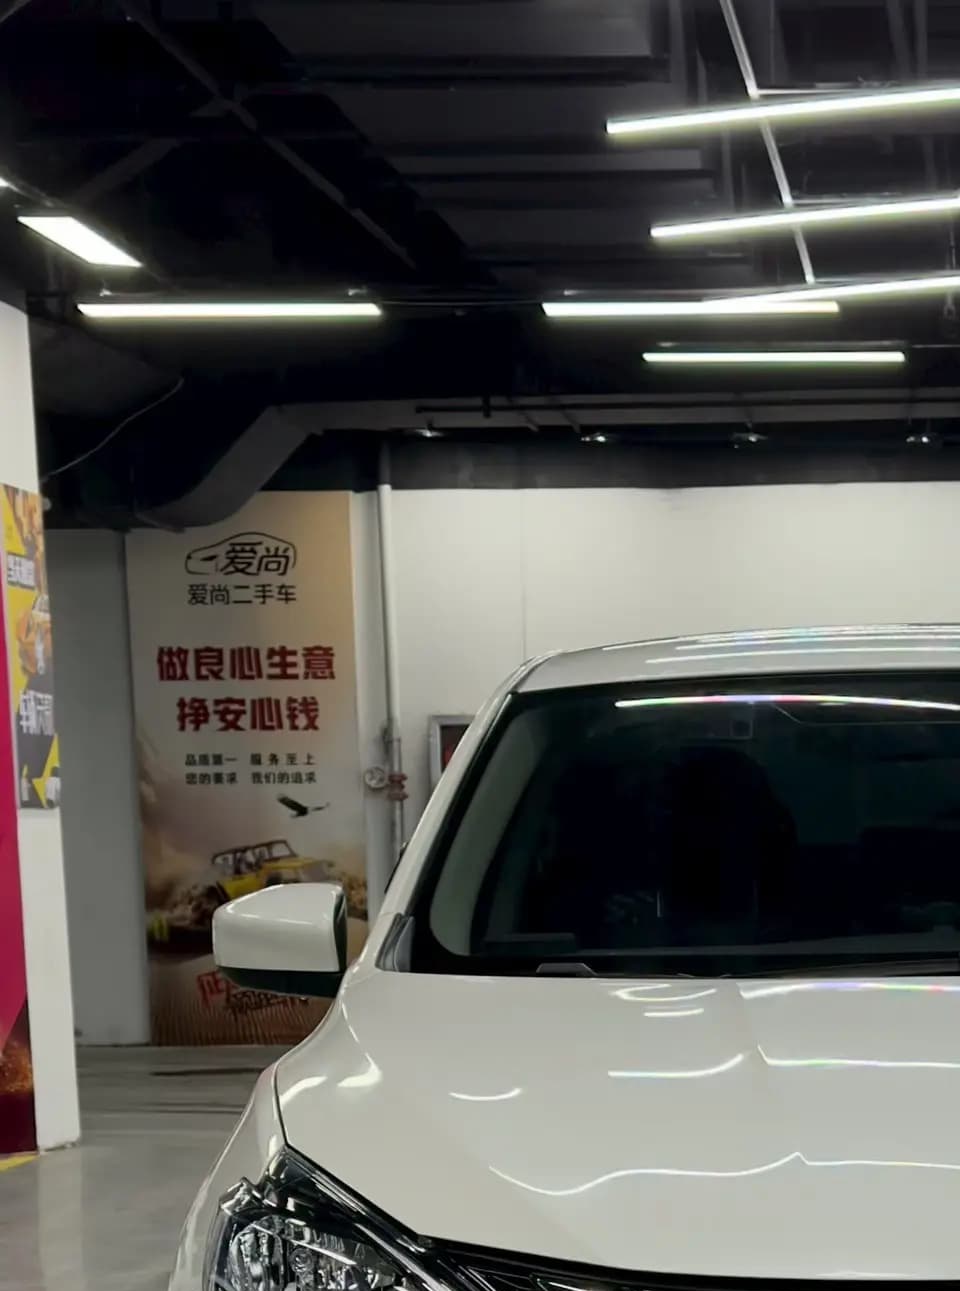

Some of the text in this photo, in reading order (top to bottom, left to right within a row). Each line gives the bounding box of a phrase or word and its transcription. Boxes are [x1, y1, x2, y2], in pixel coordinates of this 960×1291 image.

[219, 540, 290, 576] 爱尚
[187, 583, 297, 606] 爱尚二手车
[157, 645, 336, 682] 做良心生意
[177, 696, 320, 732] 挣安心钱
